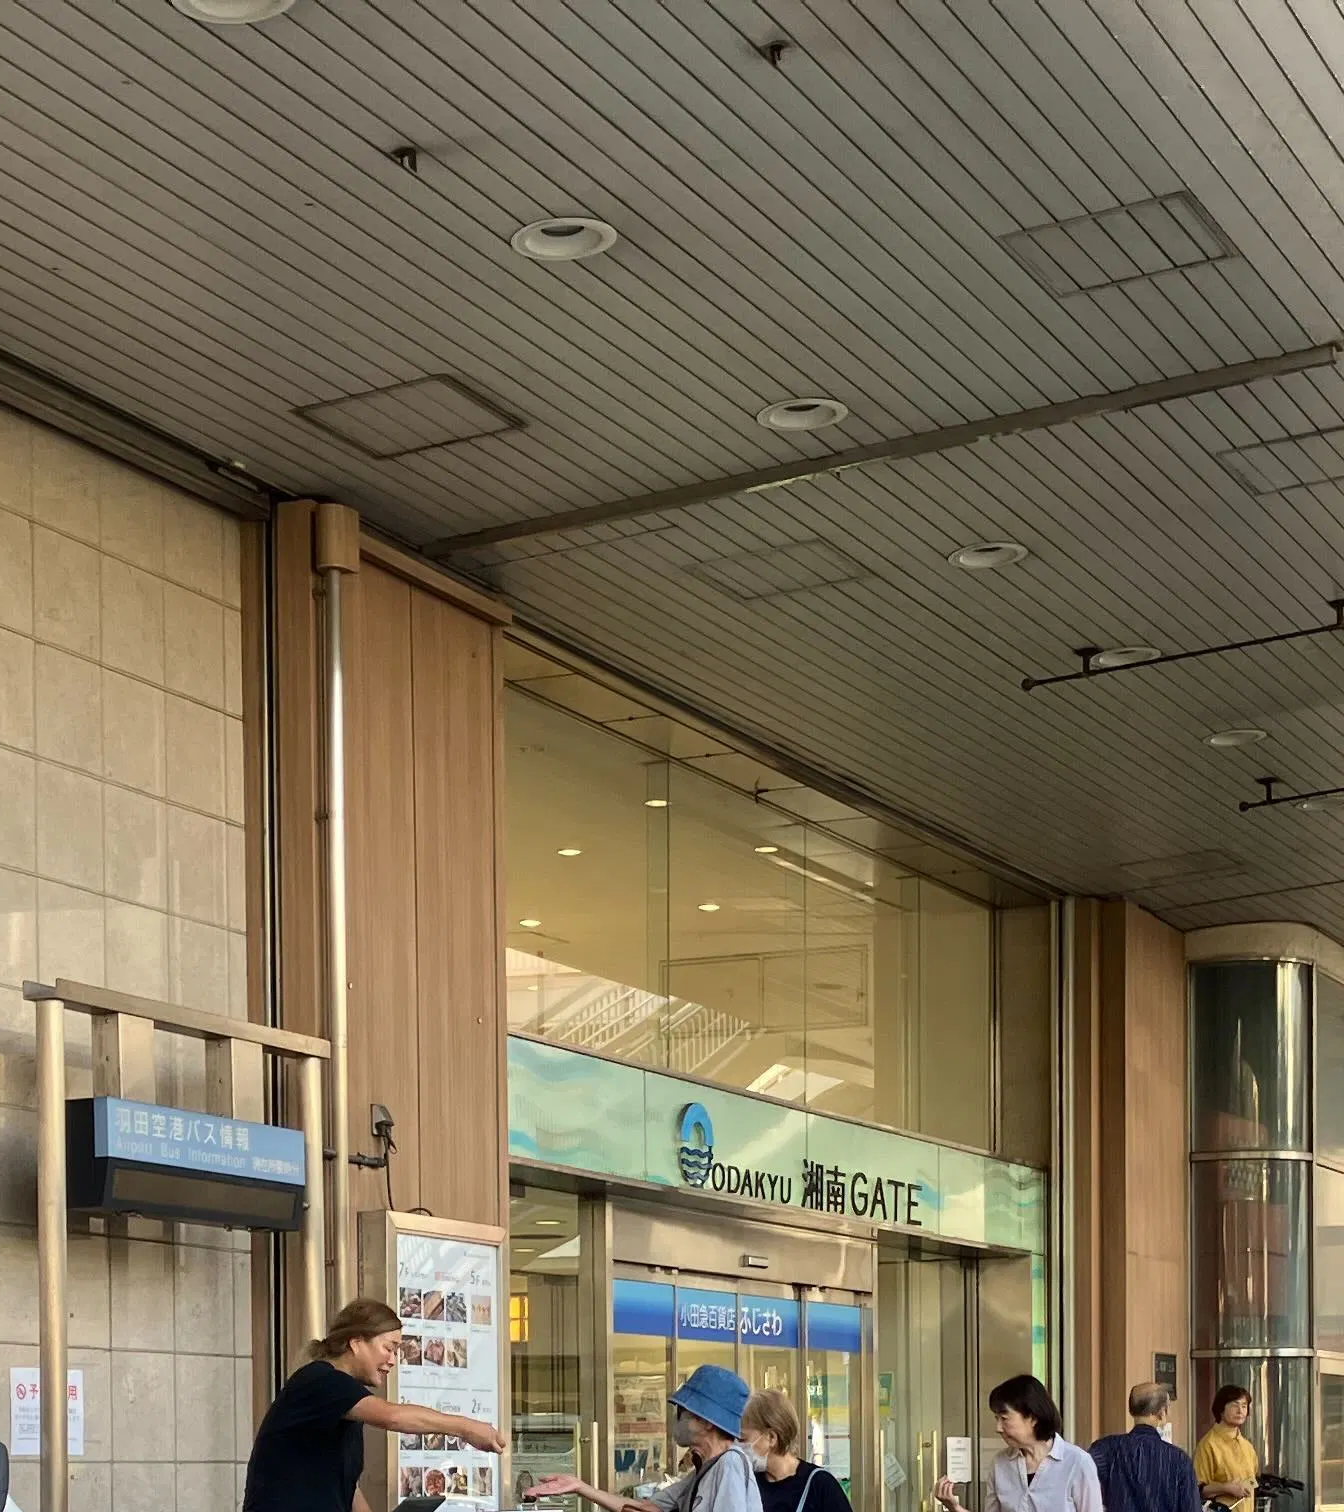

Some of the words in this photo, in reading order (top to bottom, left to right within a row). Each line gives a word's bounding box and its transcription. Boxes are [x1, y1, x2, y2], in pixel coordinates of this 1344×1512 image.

[114, 1106, 250, 1152] 羽田空港バス情報
[160, 1143, 181, 1160] Bus
[711, 1162, 792, 1204] ODAKYU
[801, 1158, 924, 1226] 湘南GATE
[679, 1303, 736, 1331] 小田急百貨店
[739, 1307, 783, 1337] ふじさわ
[29, 1384, 78, 1401] 予用
